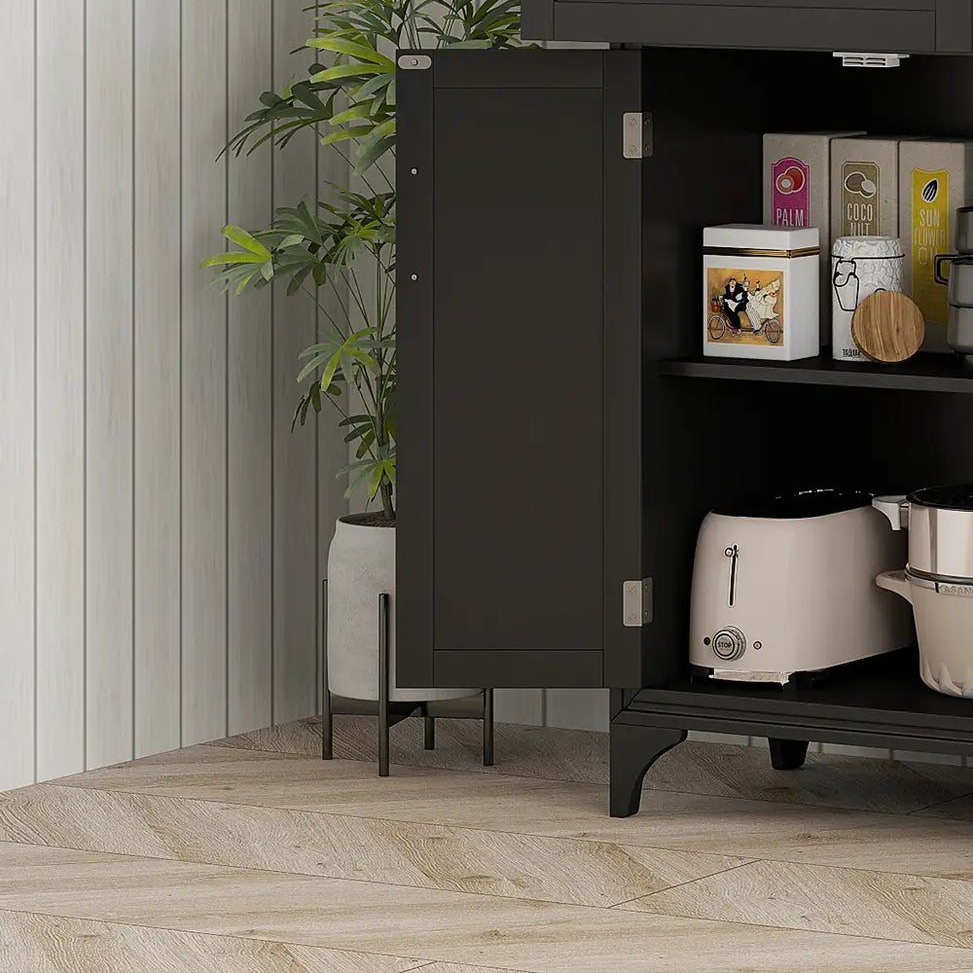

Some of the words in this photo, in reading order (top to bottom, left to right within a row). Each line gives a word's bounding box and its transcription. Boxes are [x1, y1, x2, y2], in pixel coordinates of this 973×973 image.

[776, 208, 804, 226] PALM
[847, 203, 873, 222] COCO
[919, 209, 940, 227] SUN
[914, 228, 945, 247] FLOWER
